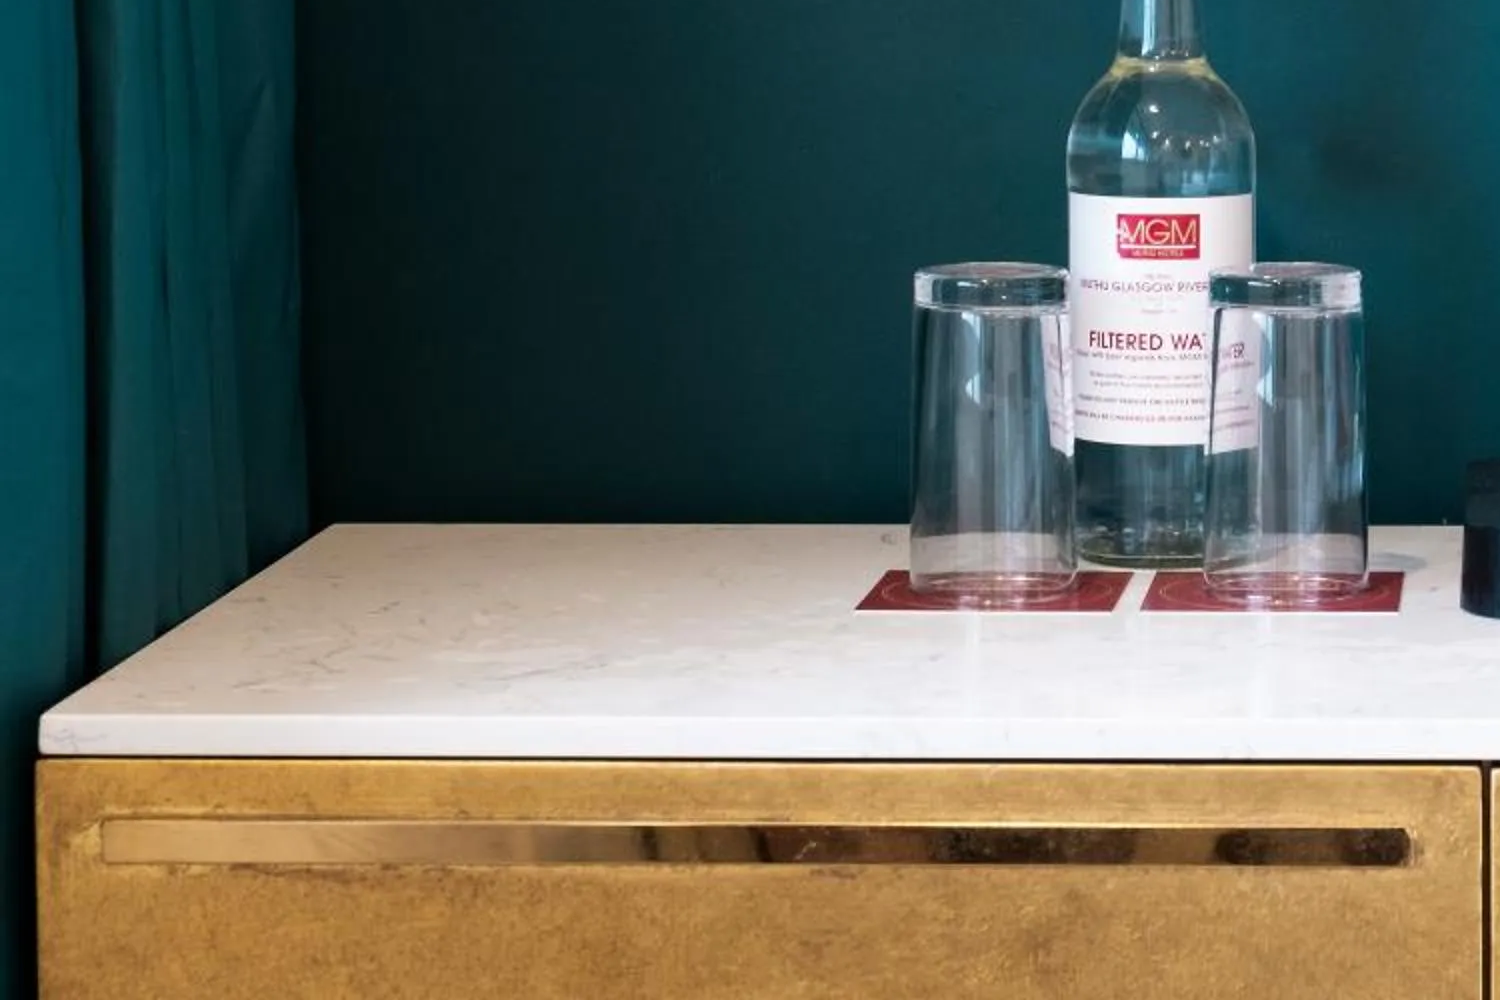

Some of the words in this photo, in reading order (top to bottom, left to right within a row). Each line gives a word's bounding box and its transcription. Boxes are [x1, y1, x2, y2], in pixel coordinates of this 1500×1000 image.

[1119, 217, 1198, 245] MGM
[1111, 280, 1173, 293] GLASGOW
[1088, 330, 1164, 351] FILTERED
[1171, 332, 1208, 350] WA
